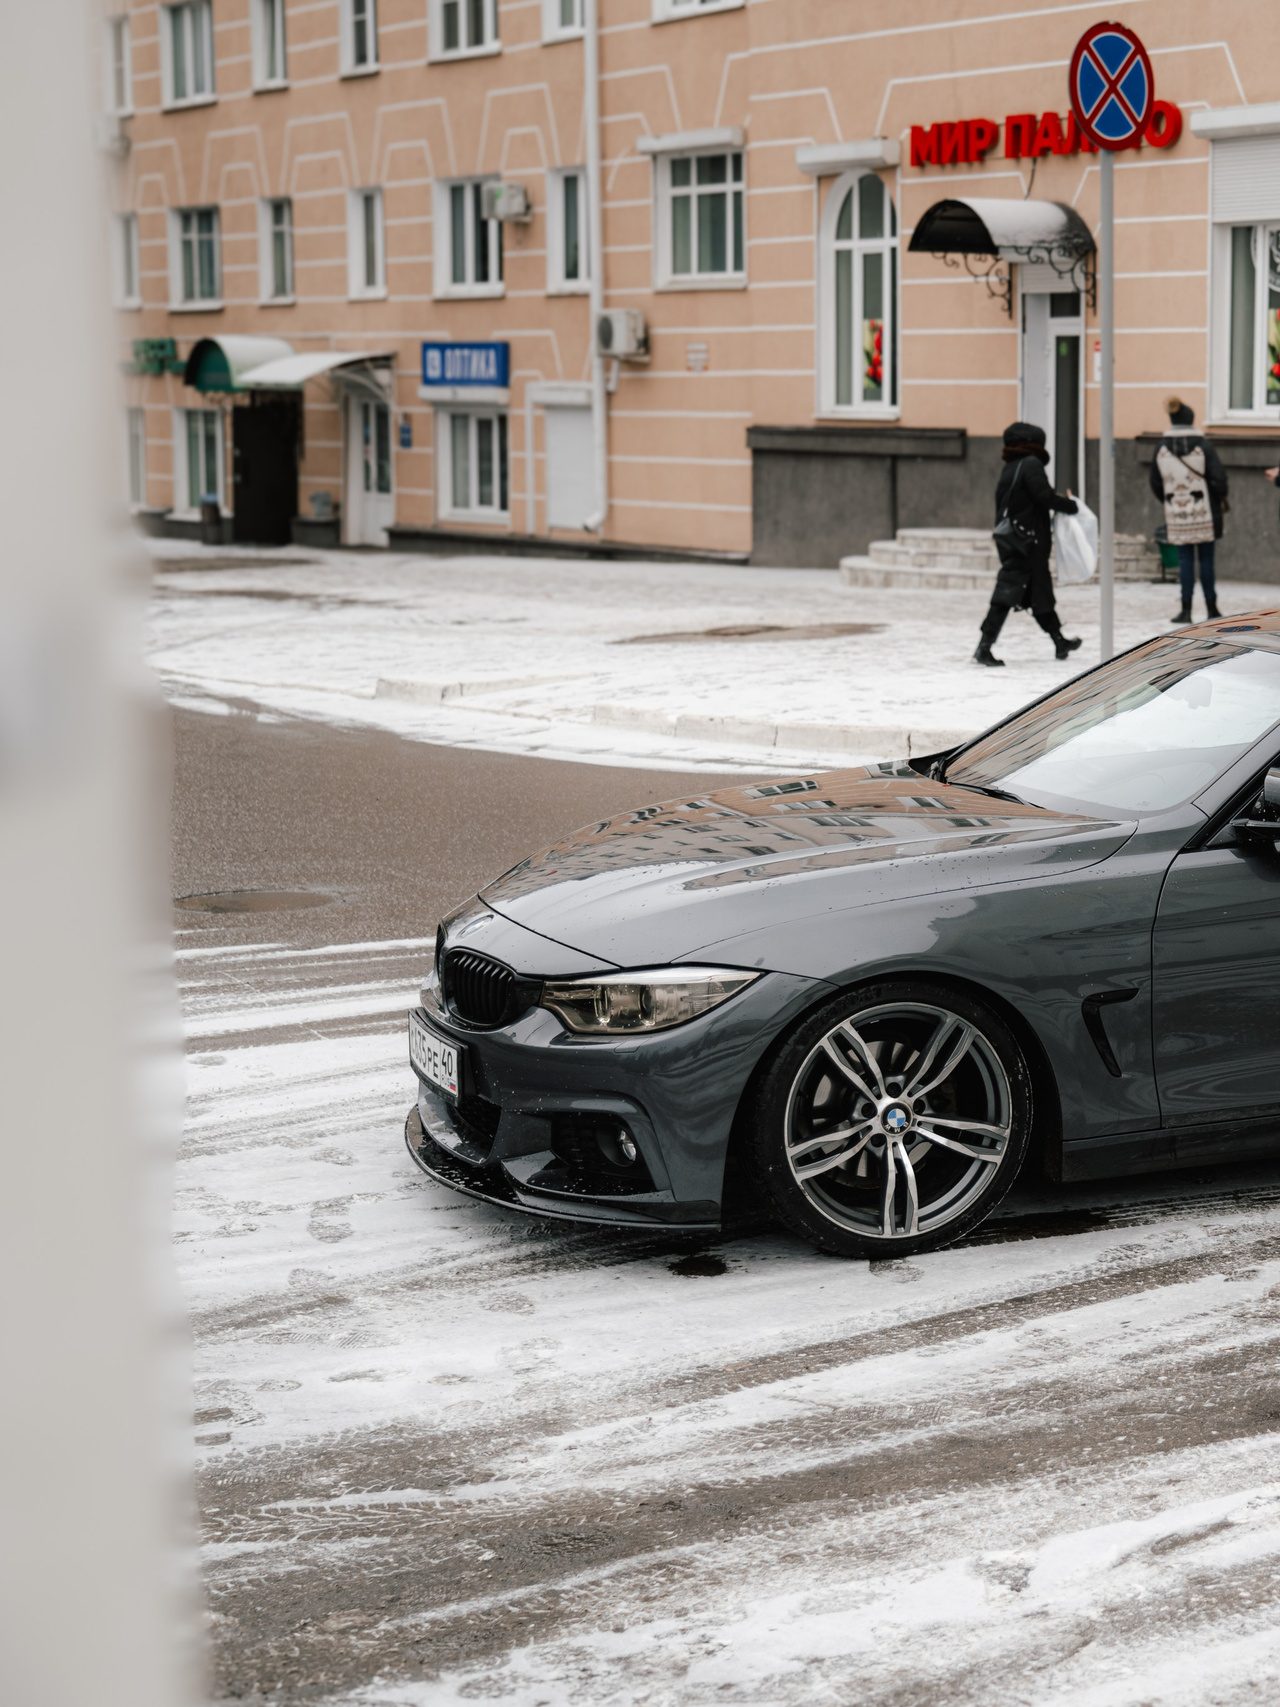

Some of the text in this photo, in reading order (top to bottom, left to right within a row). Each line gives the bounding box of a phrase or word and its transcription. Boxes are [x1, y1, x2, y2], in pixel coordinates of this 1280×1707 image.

[910, 99, 1183, 167] МИР ПАЛО
[444, 348, 497, 380] ОПТИКА
[441, 1047, 453, 1078] 40
